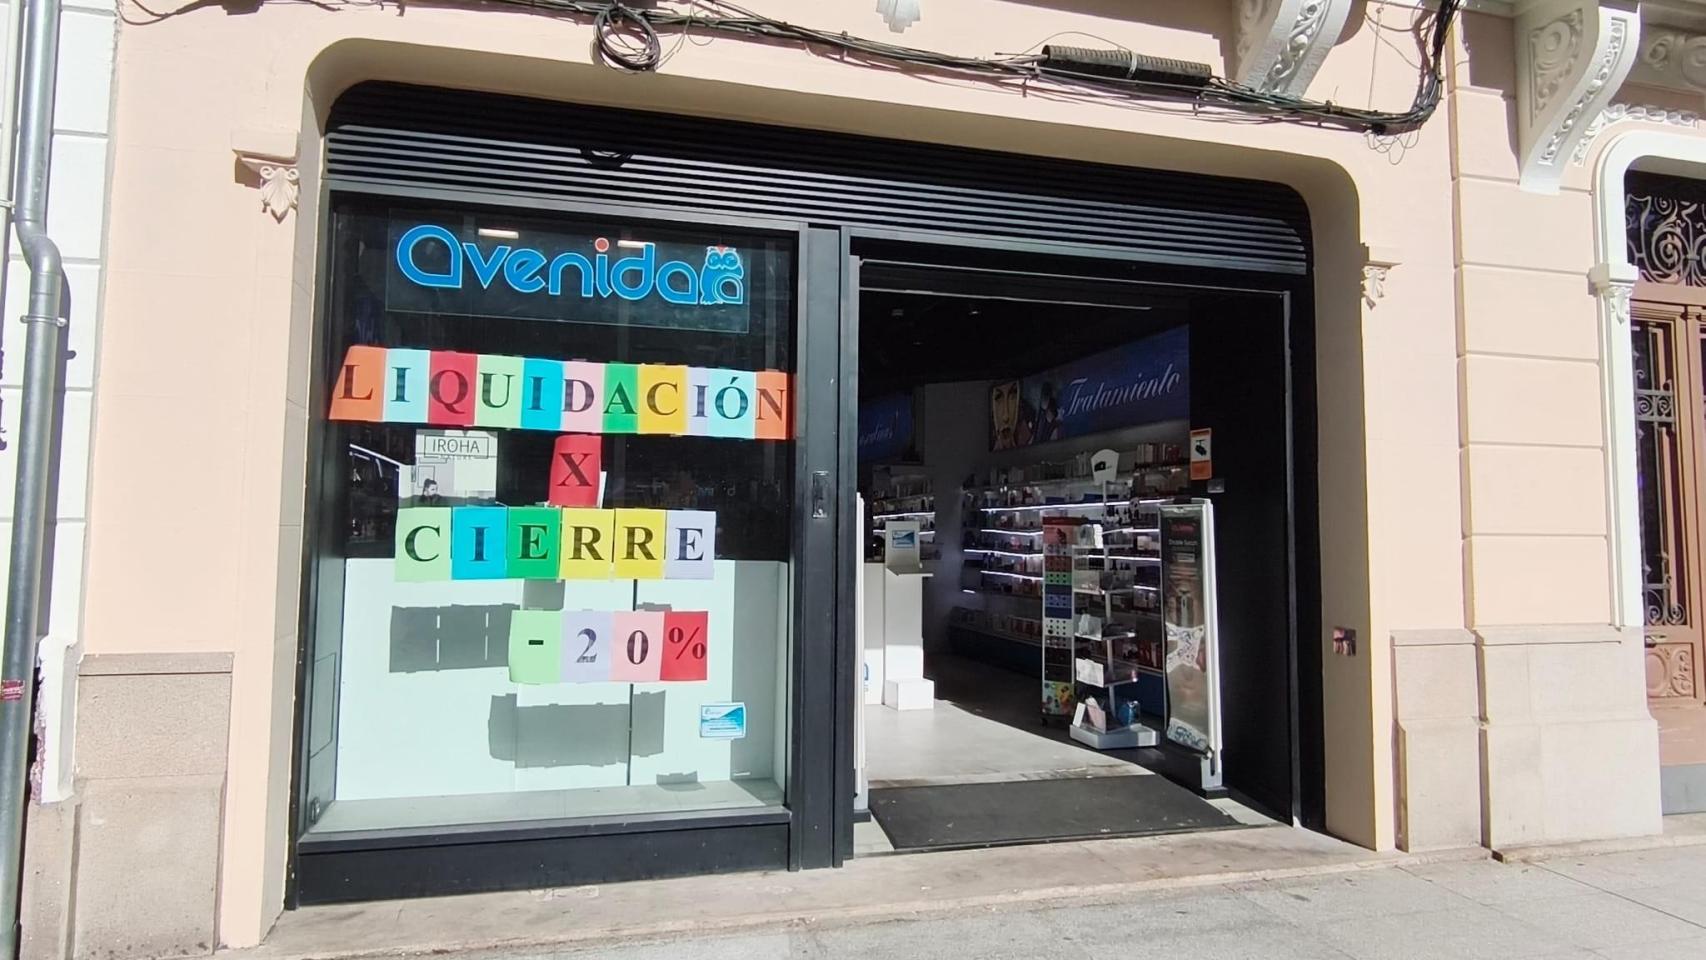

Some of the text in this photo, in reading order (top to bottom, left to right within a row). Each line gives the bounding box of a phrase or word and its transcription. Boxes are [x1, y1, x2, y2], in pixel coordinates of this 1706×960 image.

[396, 224, 698, 304] avenida
[338, 364, 786, 421] LIQUIDACIÓN
[1066, 363, 1181, 416] Tratamiento
[432, 438, 480, 453] IROHA
[558, 452, 594, 488] X
[404, 524, 706, 562] CIERRE
